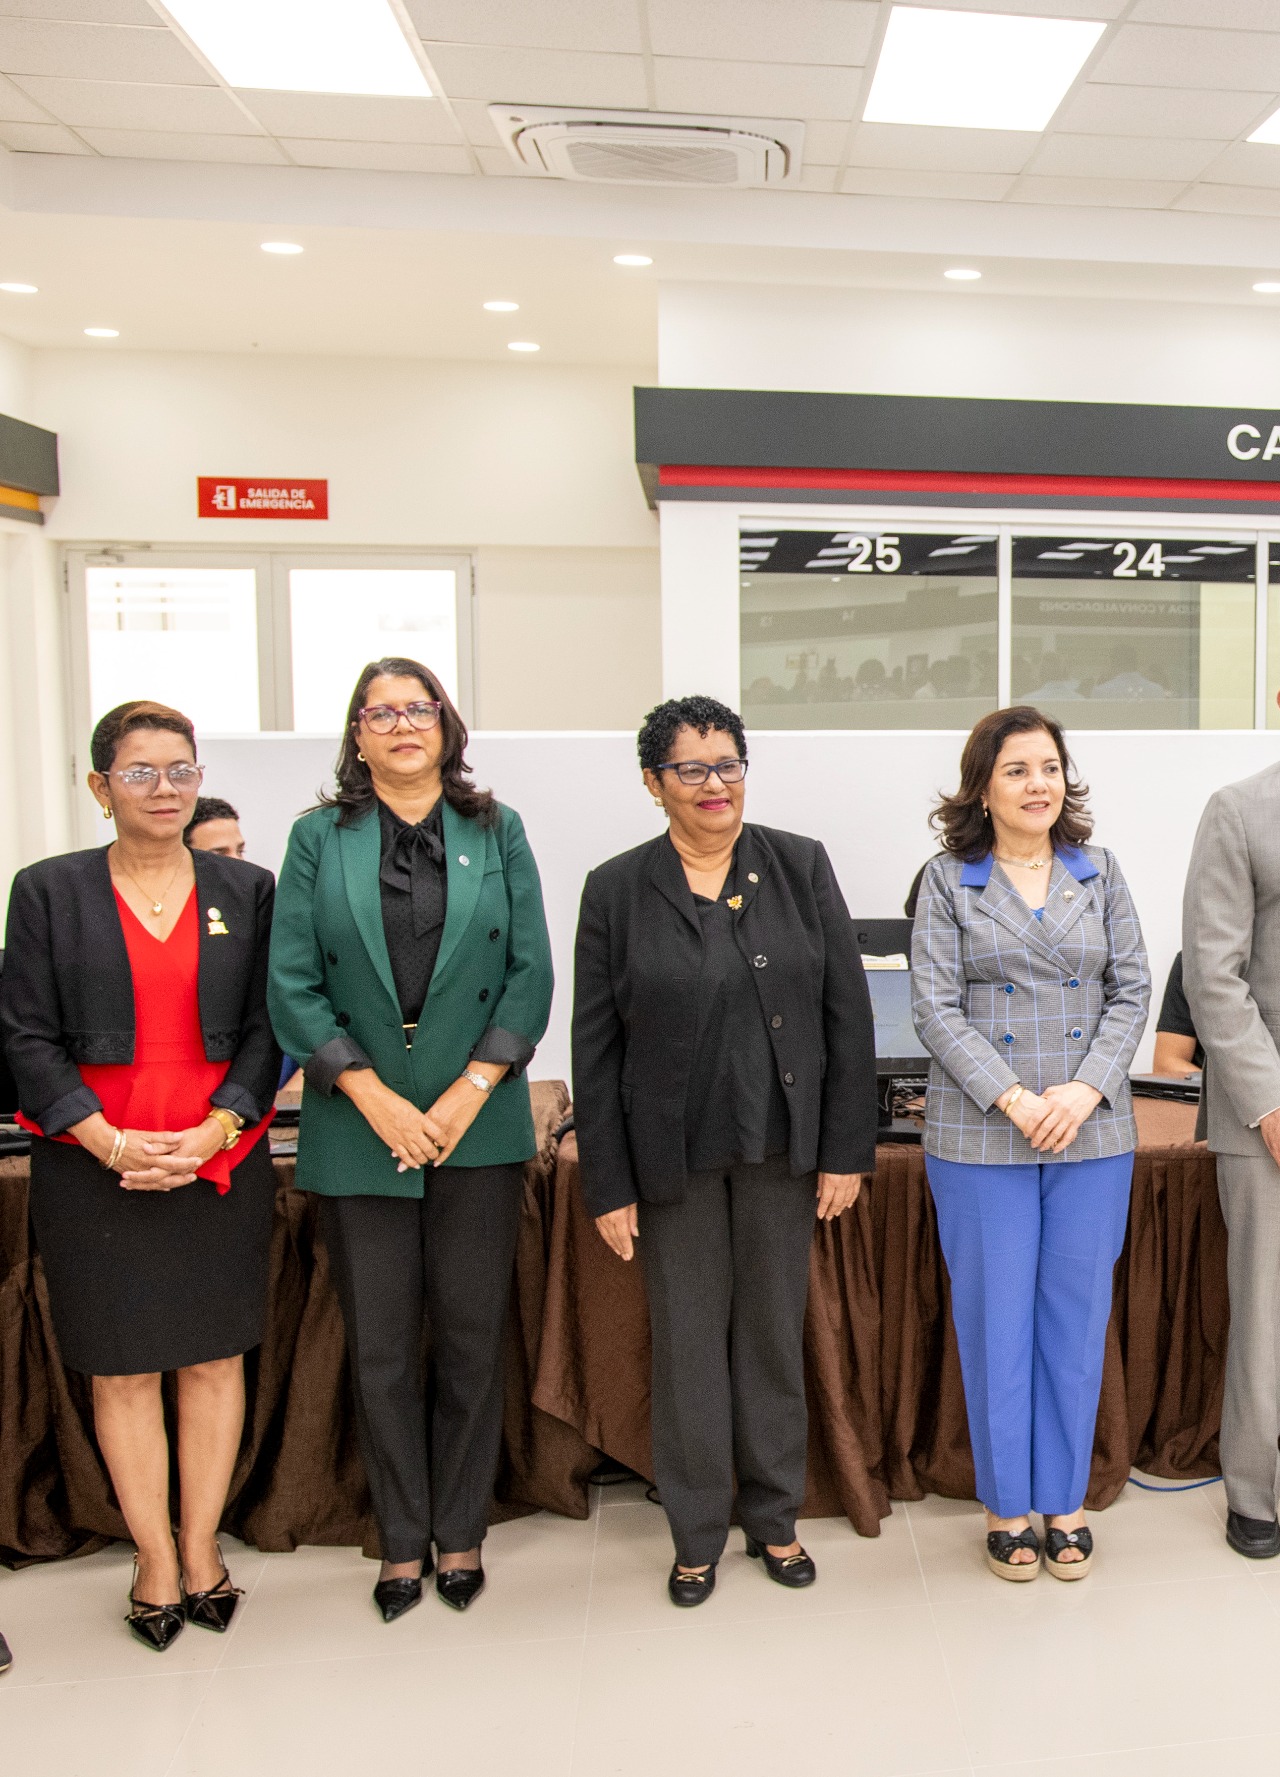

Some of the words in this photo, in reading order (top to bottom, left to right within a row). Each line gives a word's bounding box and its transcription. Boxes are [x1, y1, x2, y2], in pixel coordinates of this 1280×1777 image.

[239, 498, 316, 510] EMERGENCIA
[247, 488, 289, 499] SALIDA
[291, 488, 306, 499] DE
[847, 536, 902, 572] 25
[1112, 542, 1166, 577] 24
